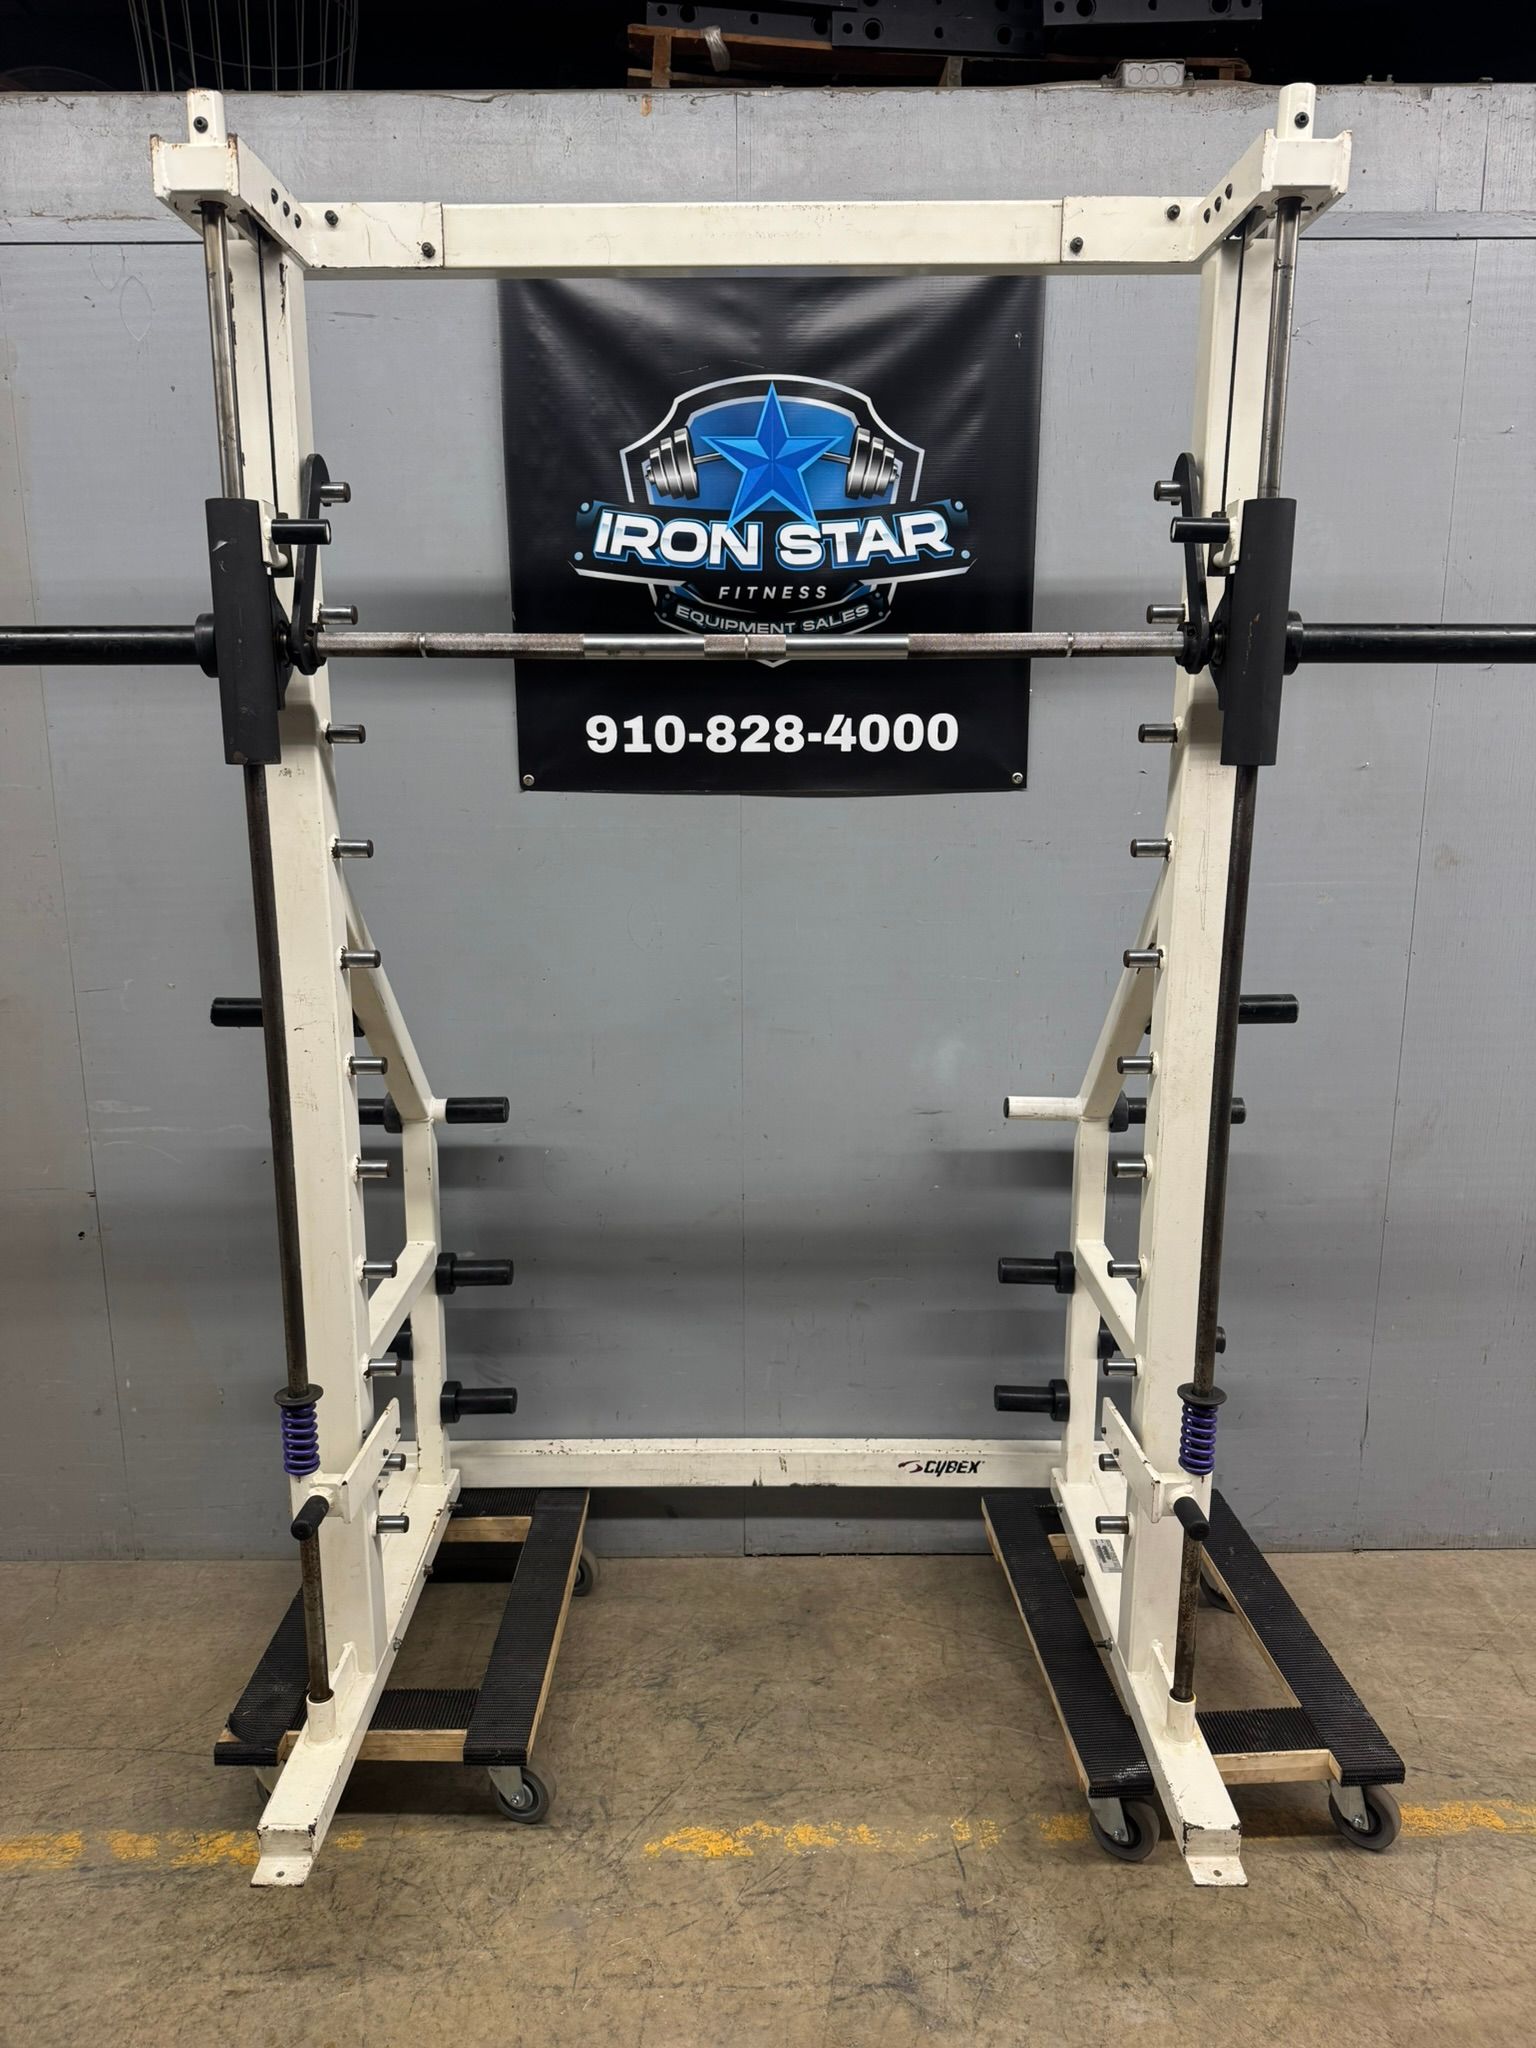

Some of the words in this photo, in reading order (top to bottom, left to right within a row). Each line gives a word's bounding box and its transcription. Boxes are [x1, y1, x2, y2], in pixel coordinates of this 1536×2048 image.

[595, 510, 761, 568] IRON
[777, 511, 953, 568] STAR
[718, 585, 828, 600] FITNESS
[675, 603, 796, 634] EQUIPMENT
[802, 604, 870, 631] SALES
[585, 713, 959, 754] 910-828-4000
[923, 1460, 981, 1477] CYBEX
